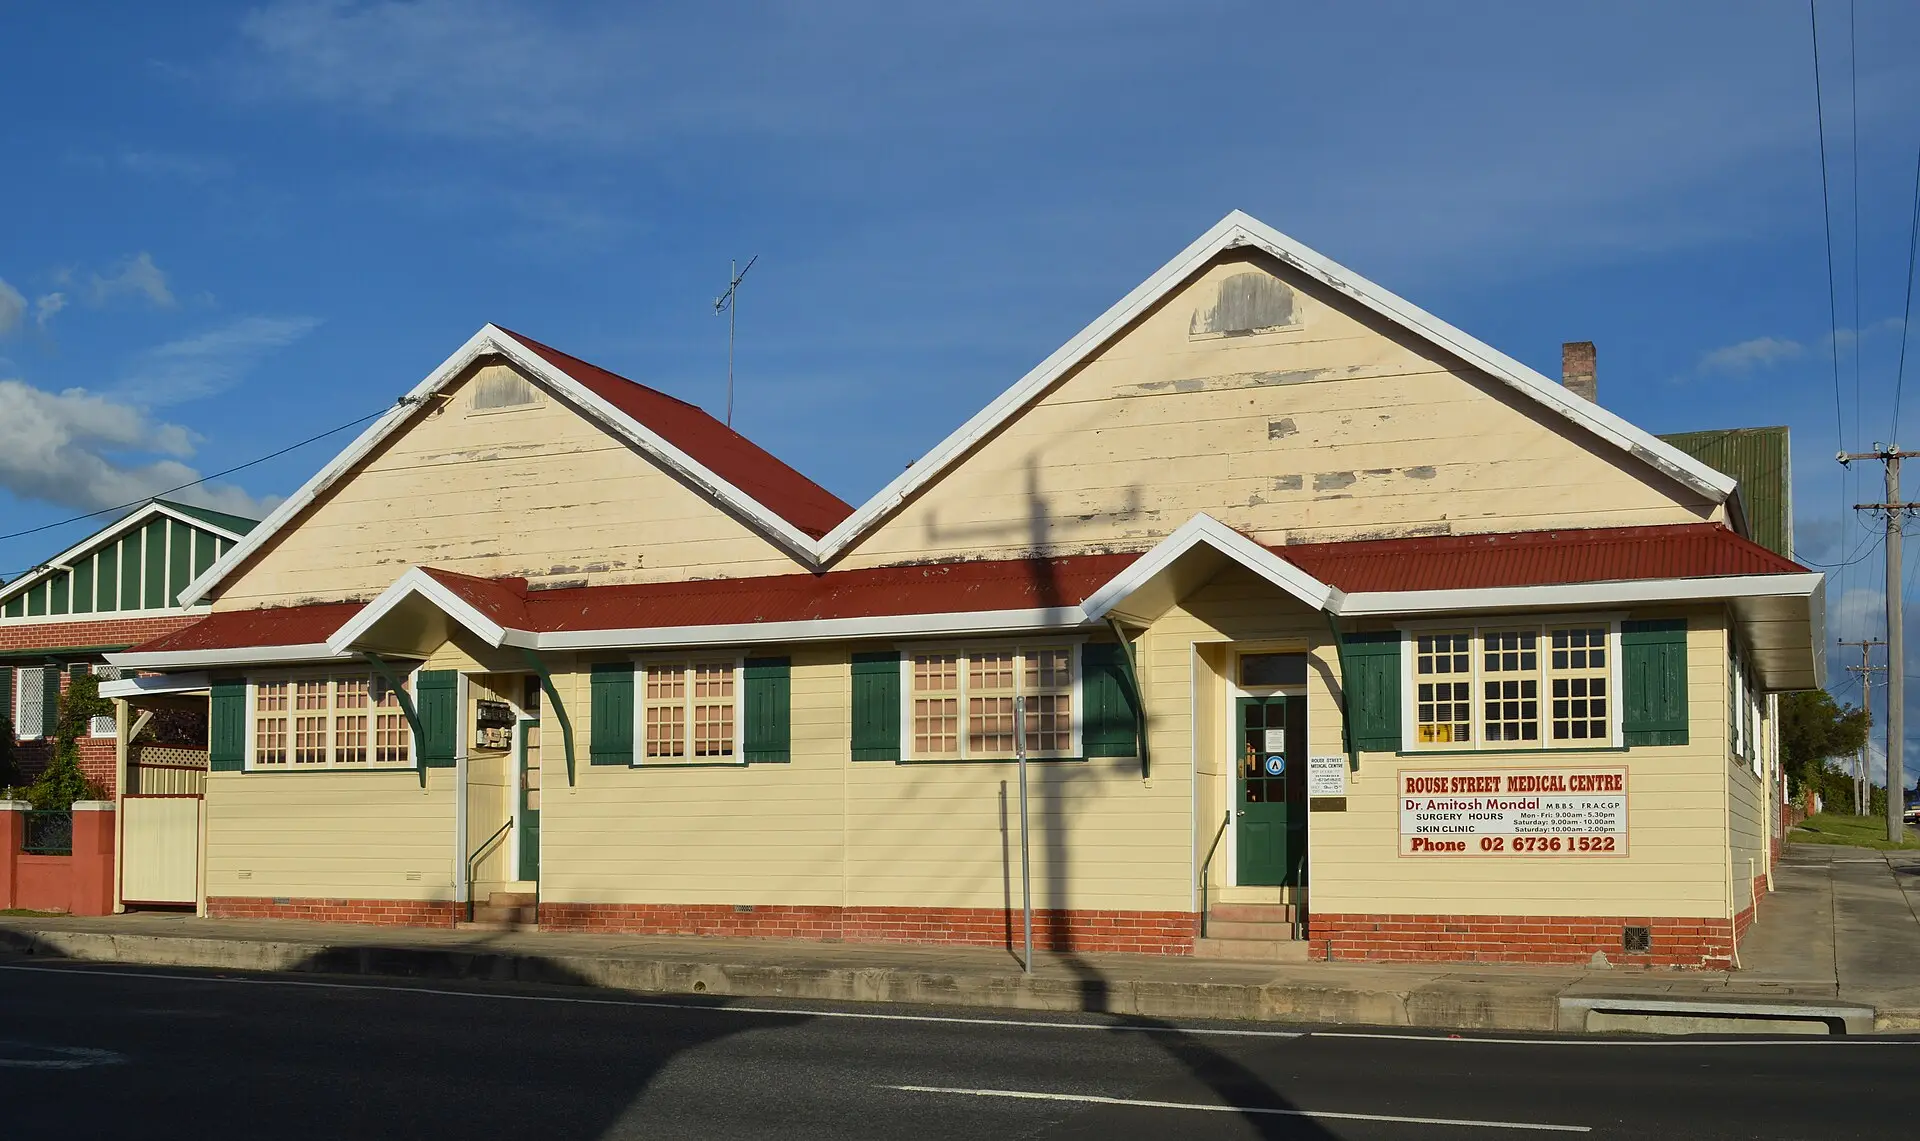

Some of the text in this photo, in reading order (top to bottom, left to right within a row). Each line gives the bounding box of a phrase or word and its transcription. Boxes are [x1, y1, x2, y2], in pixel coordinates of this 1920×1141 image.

[1406, 774, 1622, 793] ROUSE STREET MEDICAL CENTRE
[1405, 799, 1423, 810] Dr.
[1426, 798, 1482, 810] Amitosh
[1486, 797, 1539, 810] Mondal
[1411, 837, 1615, 851] Phone 02 6736 1522
